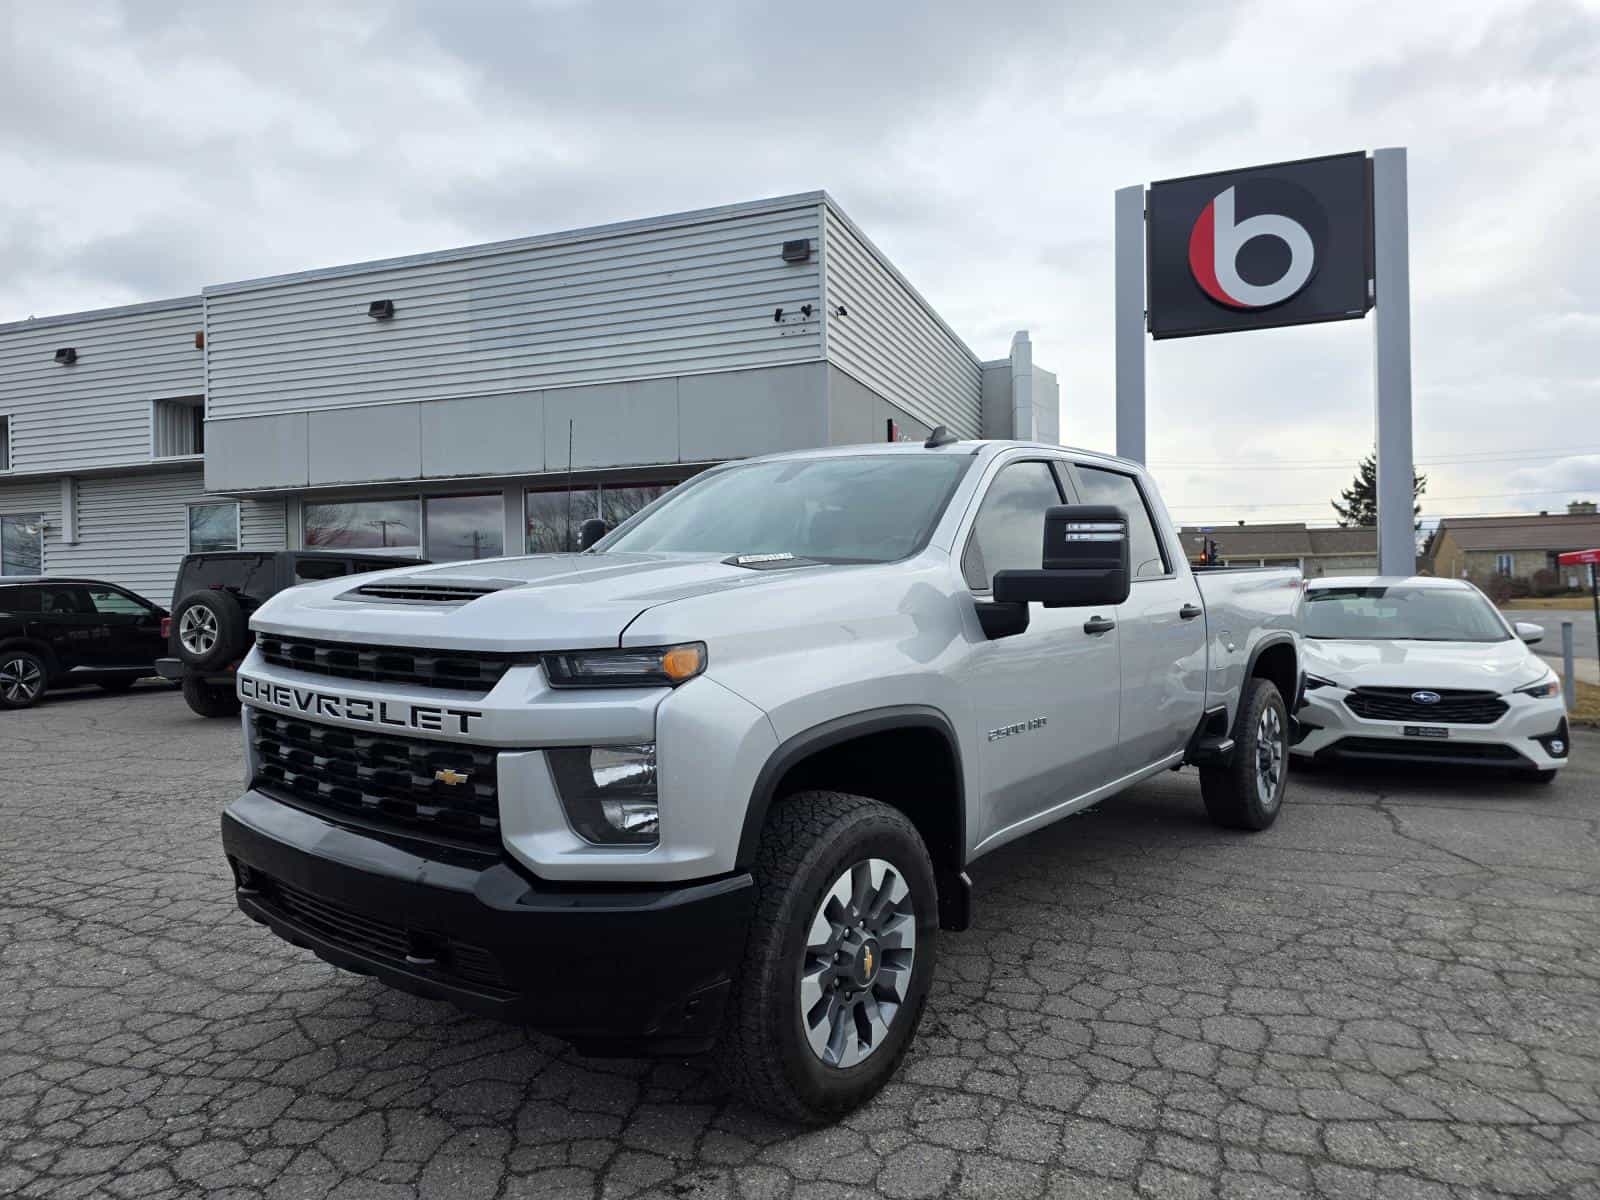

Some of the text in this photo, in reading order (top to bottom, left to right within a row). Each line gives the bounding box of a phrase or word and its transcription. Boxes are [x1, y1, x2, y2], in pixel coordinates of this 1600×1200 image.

[1212, 185, 1315, 307] b
[240, 677, 483, 734] CHEVROLET
[987, 721, 1026, 742] 2500
